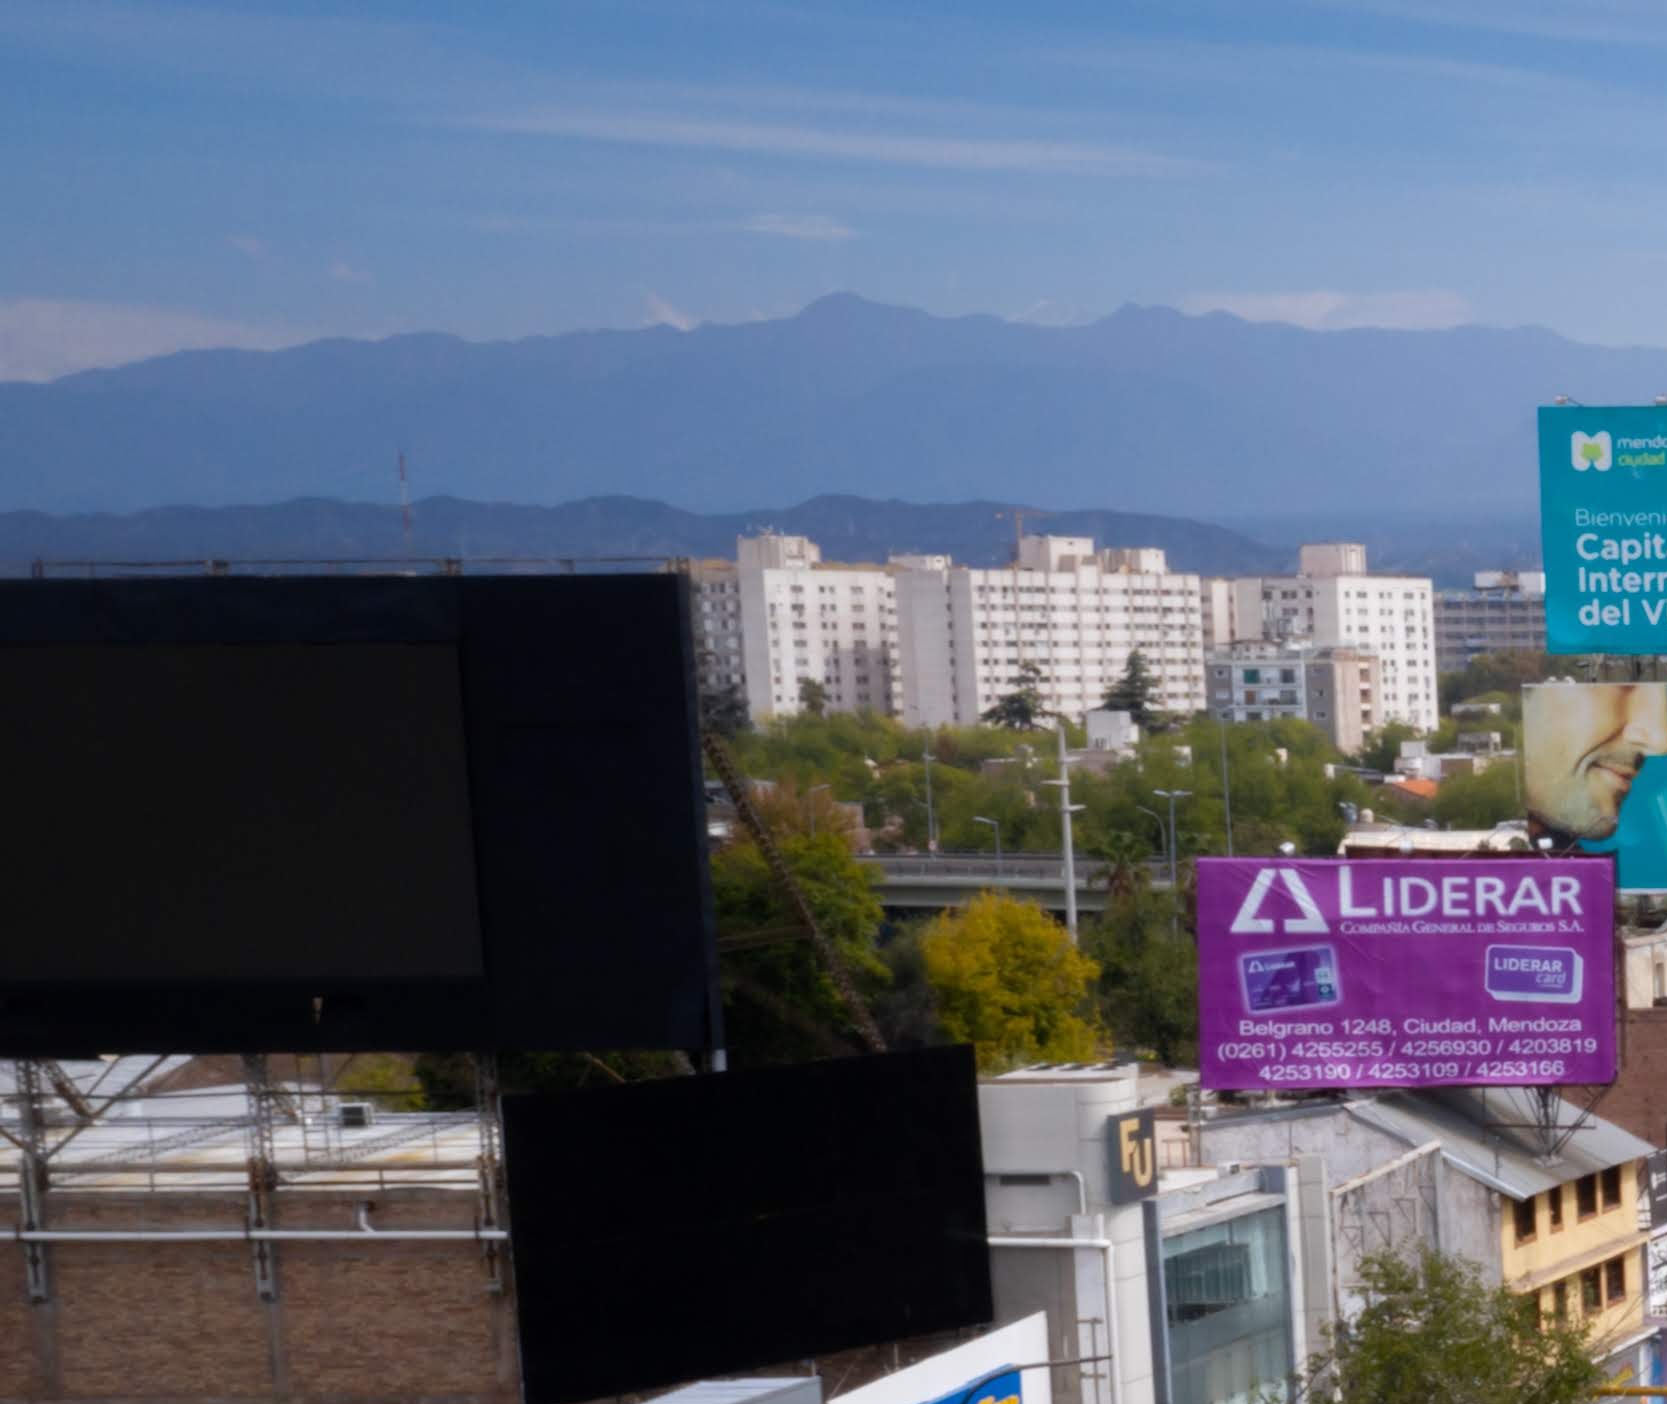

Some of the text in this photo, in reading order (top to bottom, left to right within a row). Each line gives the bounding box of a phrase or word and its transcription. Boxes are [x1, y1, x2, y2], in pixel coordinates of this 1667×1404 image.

[1578, 598, 1631, 626] del
[1339, 864, 1584, 917] LIDERAR
[1557, 920, 1585, 933] S.A.
[1493, 957, 1563, 973] LIDERAR
[1535, 971, 1567, 985] card
[1239, 1016, 1583, 1039] Belgrano 1248, Ciudad, Mendoza
[1217, 1042, 1287, 1062] (0261)
[1291, 1040, 1384, 1058] 4255255
[1401, 1039, 1492, 1056] 4256930
[1508, 1037, 1597, 1054] 4203819
[1258, 1064, 1351, 1081] 4253190
[1368, 1062, 1459, 1079] 4253109
[1475, 1060, 1565, 1077] 4253166
